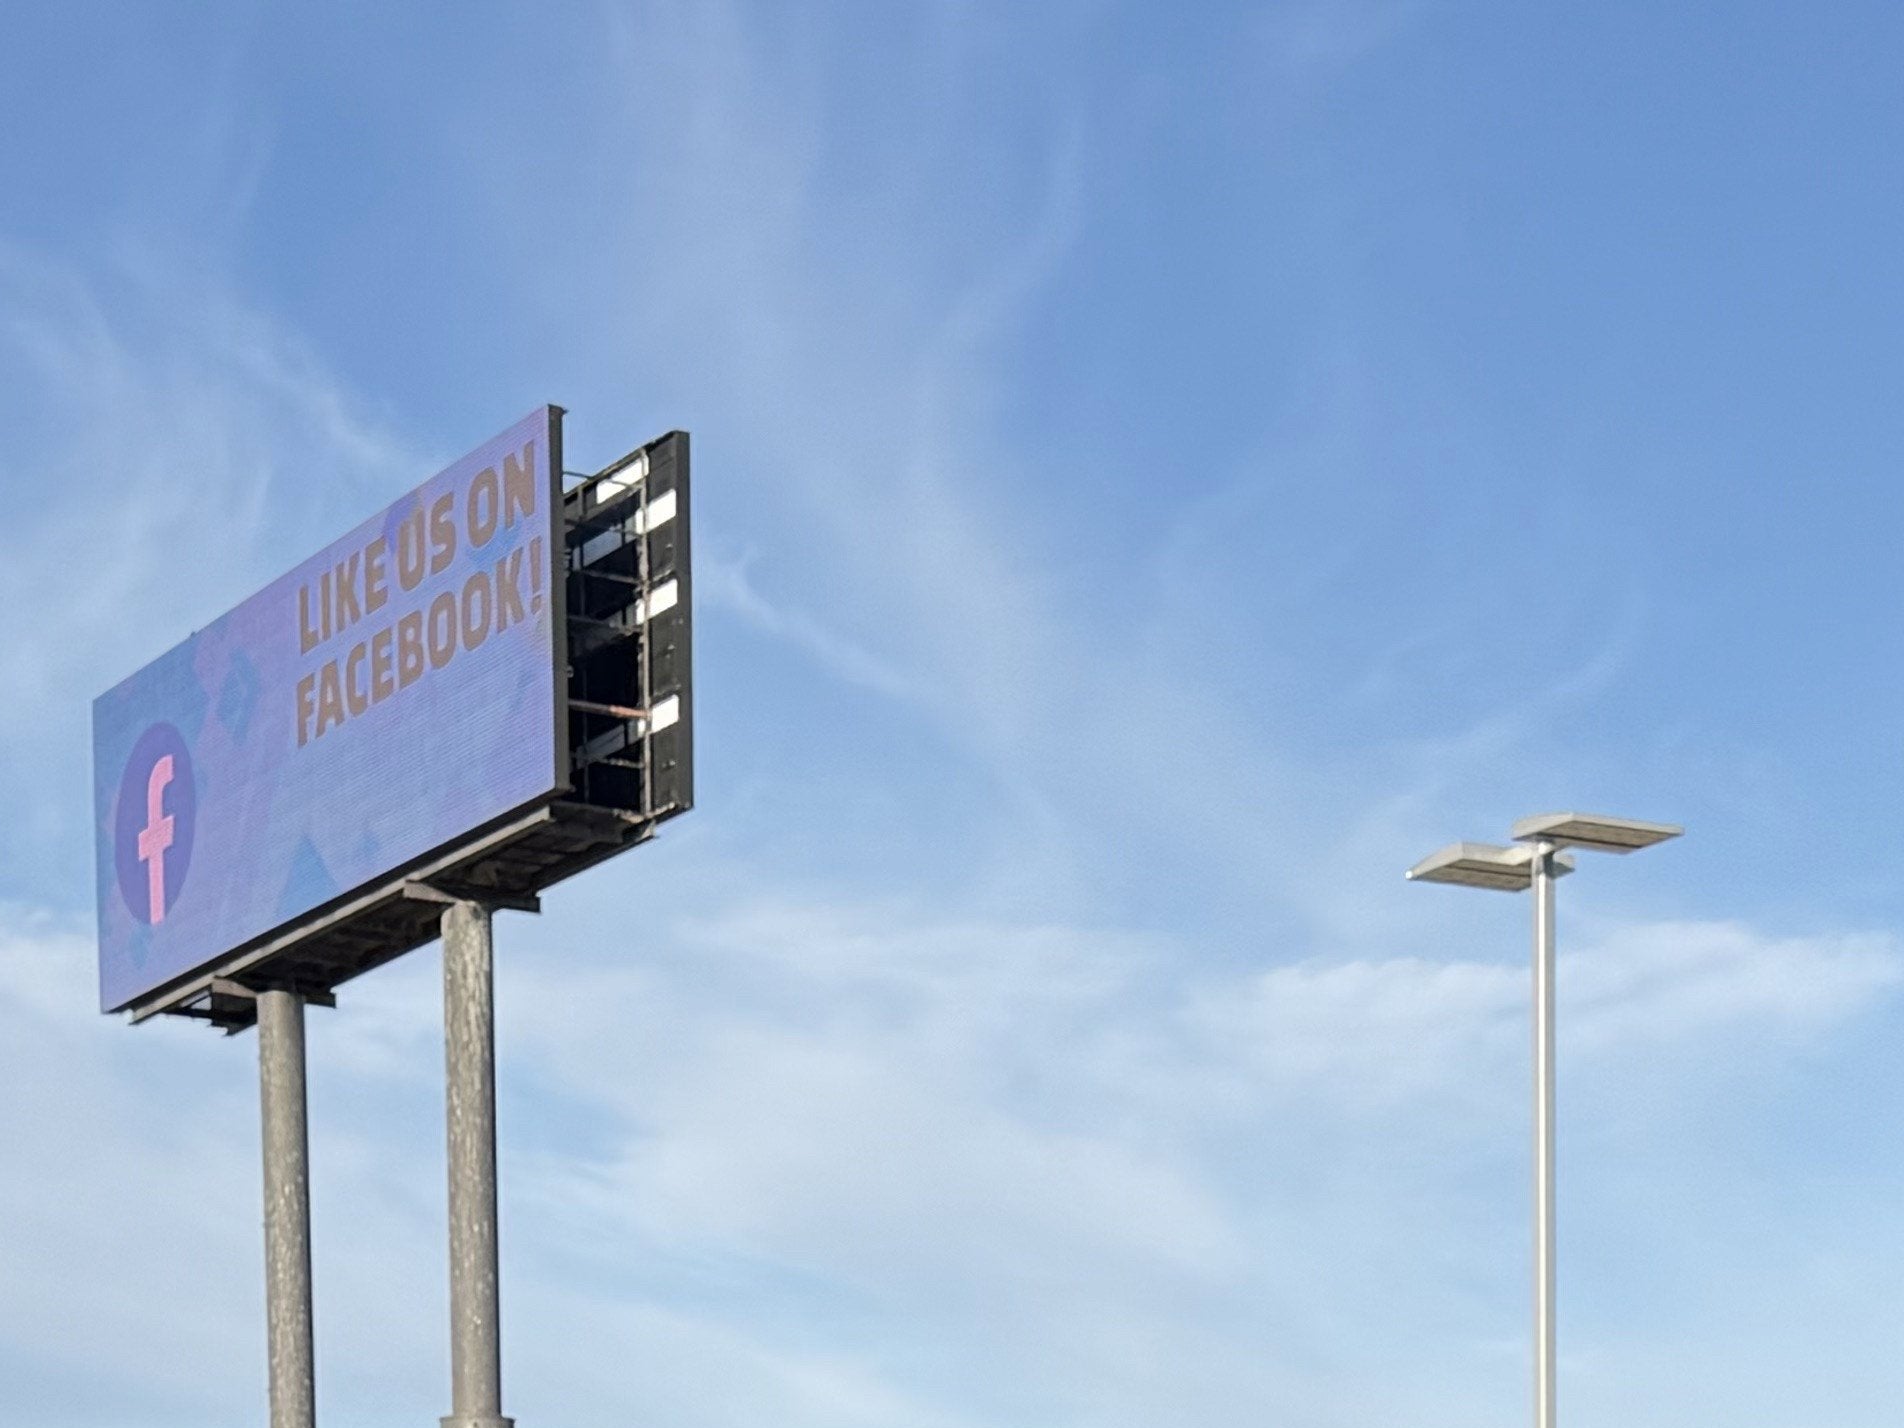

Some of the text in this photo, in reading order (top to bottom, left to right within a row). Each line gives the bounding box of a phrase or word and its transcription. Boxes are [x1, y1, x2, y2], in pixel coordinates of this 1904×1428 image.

[297, 535, 542, 749] FACEBOOK!
[299, 439, 535, 656] LIKE US ON
